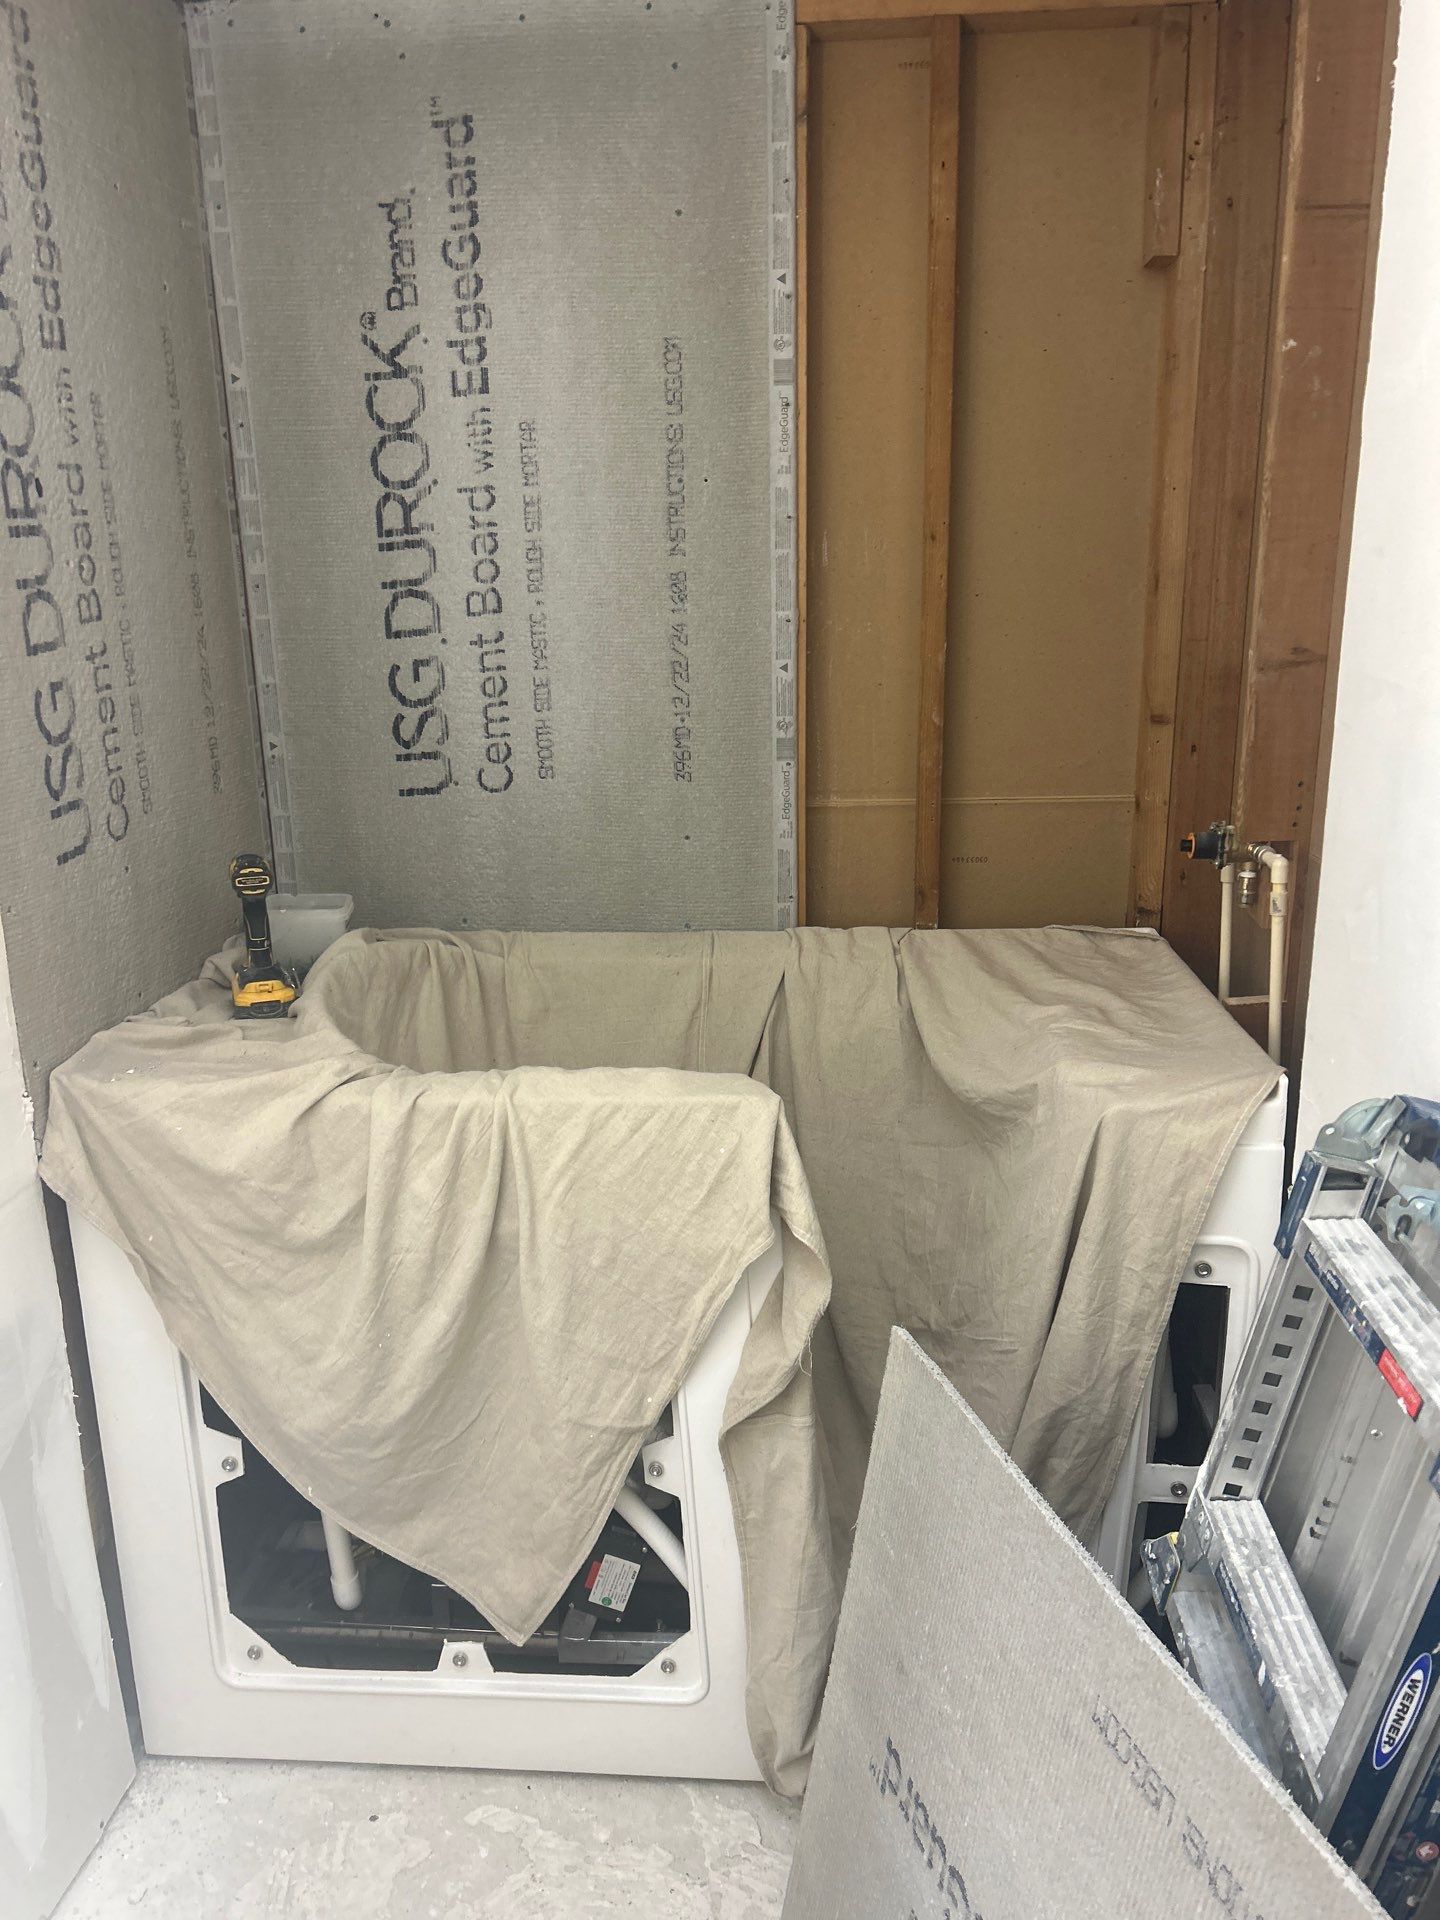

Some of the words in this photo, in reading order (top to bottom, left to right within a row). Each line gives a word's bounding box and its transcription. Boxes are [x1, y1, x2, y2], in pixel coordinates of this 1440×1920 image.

[56, 366, 80, 446] with
[466, 406, 494, 474] with
[518, 419, 540, 488] MORTAR
[101, 479, 117, 525] SIDE
[522, 494, 543, 534] SIDE
[57, 462, 103, 625] Board
[456, 484, 503, 618] Board
[524, 537, 548, 594] ROUGH
[528, 611, 549, 671] MASTIC
[670, 622, 691, 718] 12/22/24
[129, 693, 144, 737] SIDE
[387, 655, 453, 796] USG
[477, 630, 514, 793] Cement
[532, 676, 553, 714] SIDE
[34, 677, 92, 867] USG
[84, 639, 130, 842] Cement
[533, 717, 557, 781] SMOOTH
[1384, 1678, 1421, 1747] WERNER
